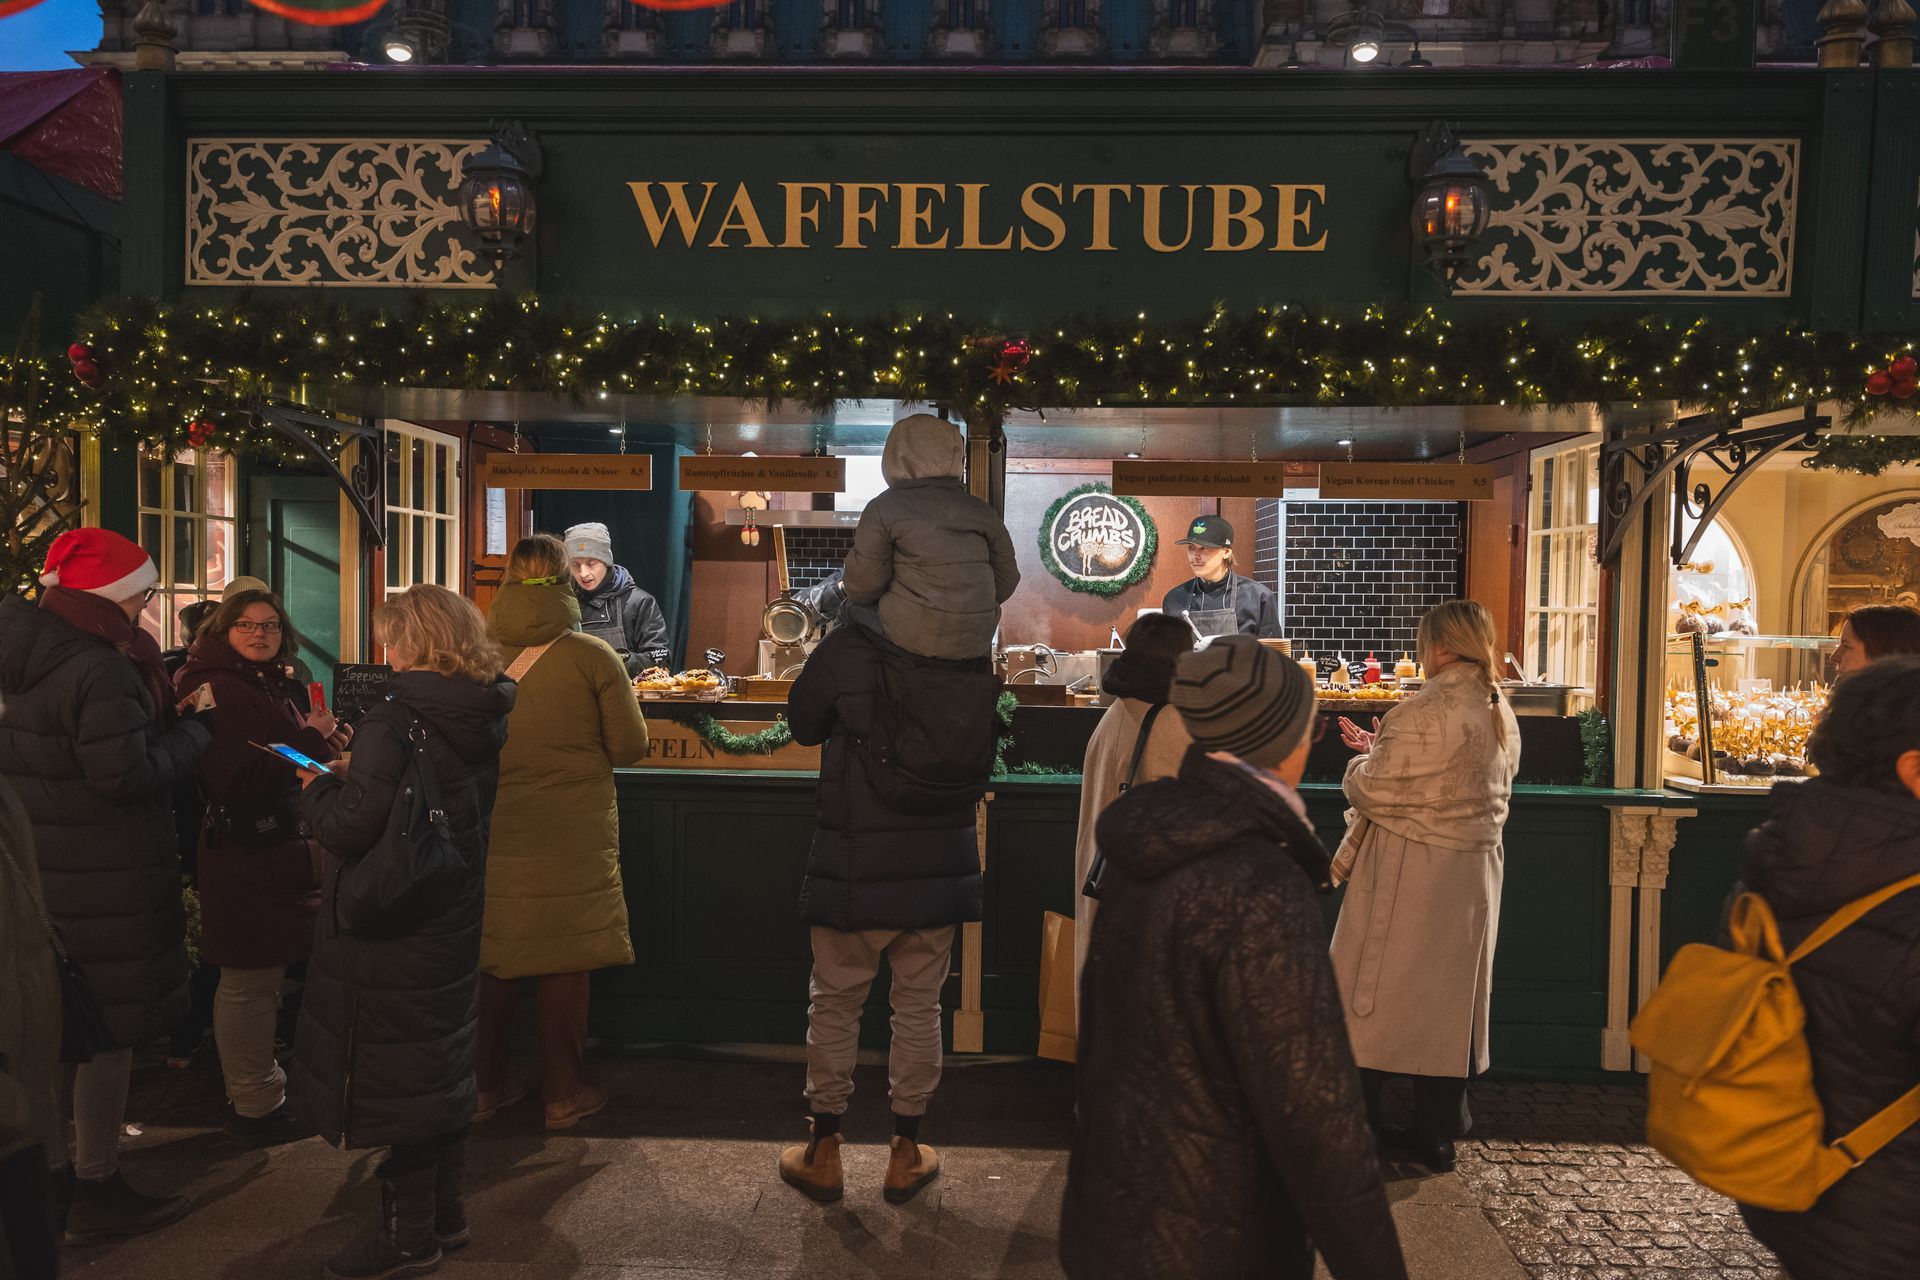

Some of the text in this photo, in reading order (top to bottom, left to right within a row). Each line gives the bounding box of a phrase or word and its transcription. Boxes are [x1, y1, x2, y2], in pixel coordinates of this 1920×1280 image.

[626, 181, 1329, 253] WAFFELSTUBE
[582, 467, 591, 476] &
[594, 466, 618, 476] Nüsse
[630, 468, 644, 477] 8,5
[757, 470, 765, 478] &
[825, 471, 838, 480] 8,5
[1118, 474, 1145, 484] Vegan
[1148, 474, 1176, 484] pulled
[1201, 475, 1210, 483] &
[1214, 474, 1250, 484] Rotkohl
[1326, 476, 1487, 486] Vegan Korean fried Chicken 9,5
[1065, 505, 1128, 532] BREAD
[1057, 528, 1135, 552] CRUMBS
[342, 665, 388, 683] Toppings
[337, 683, 376, 696] Nutella
